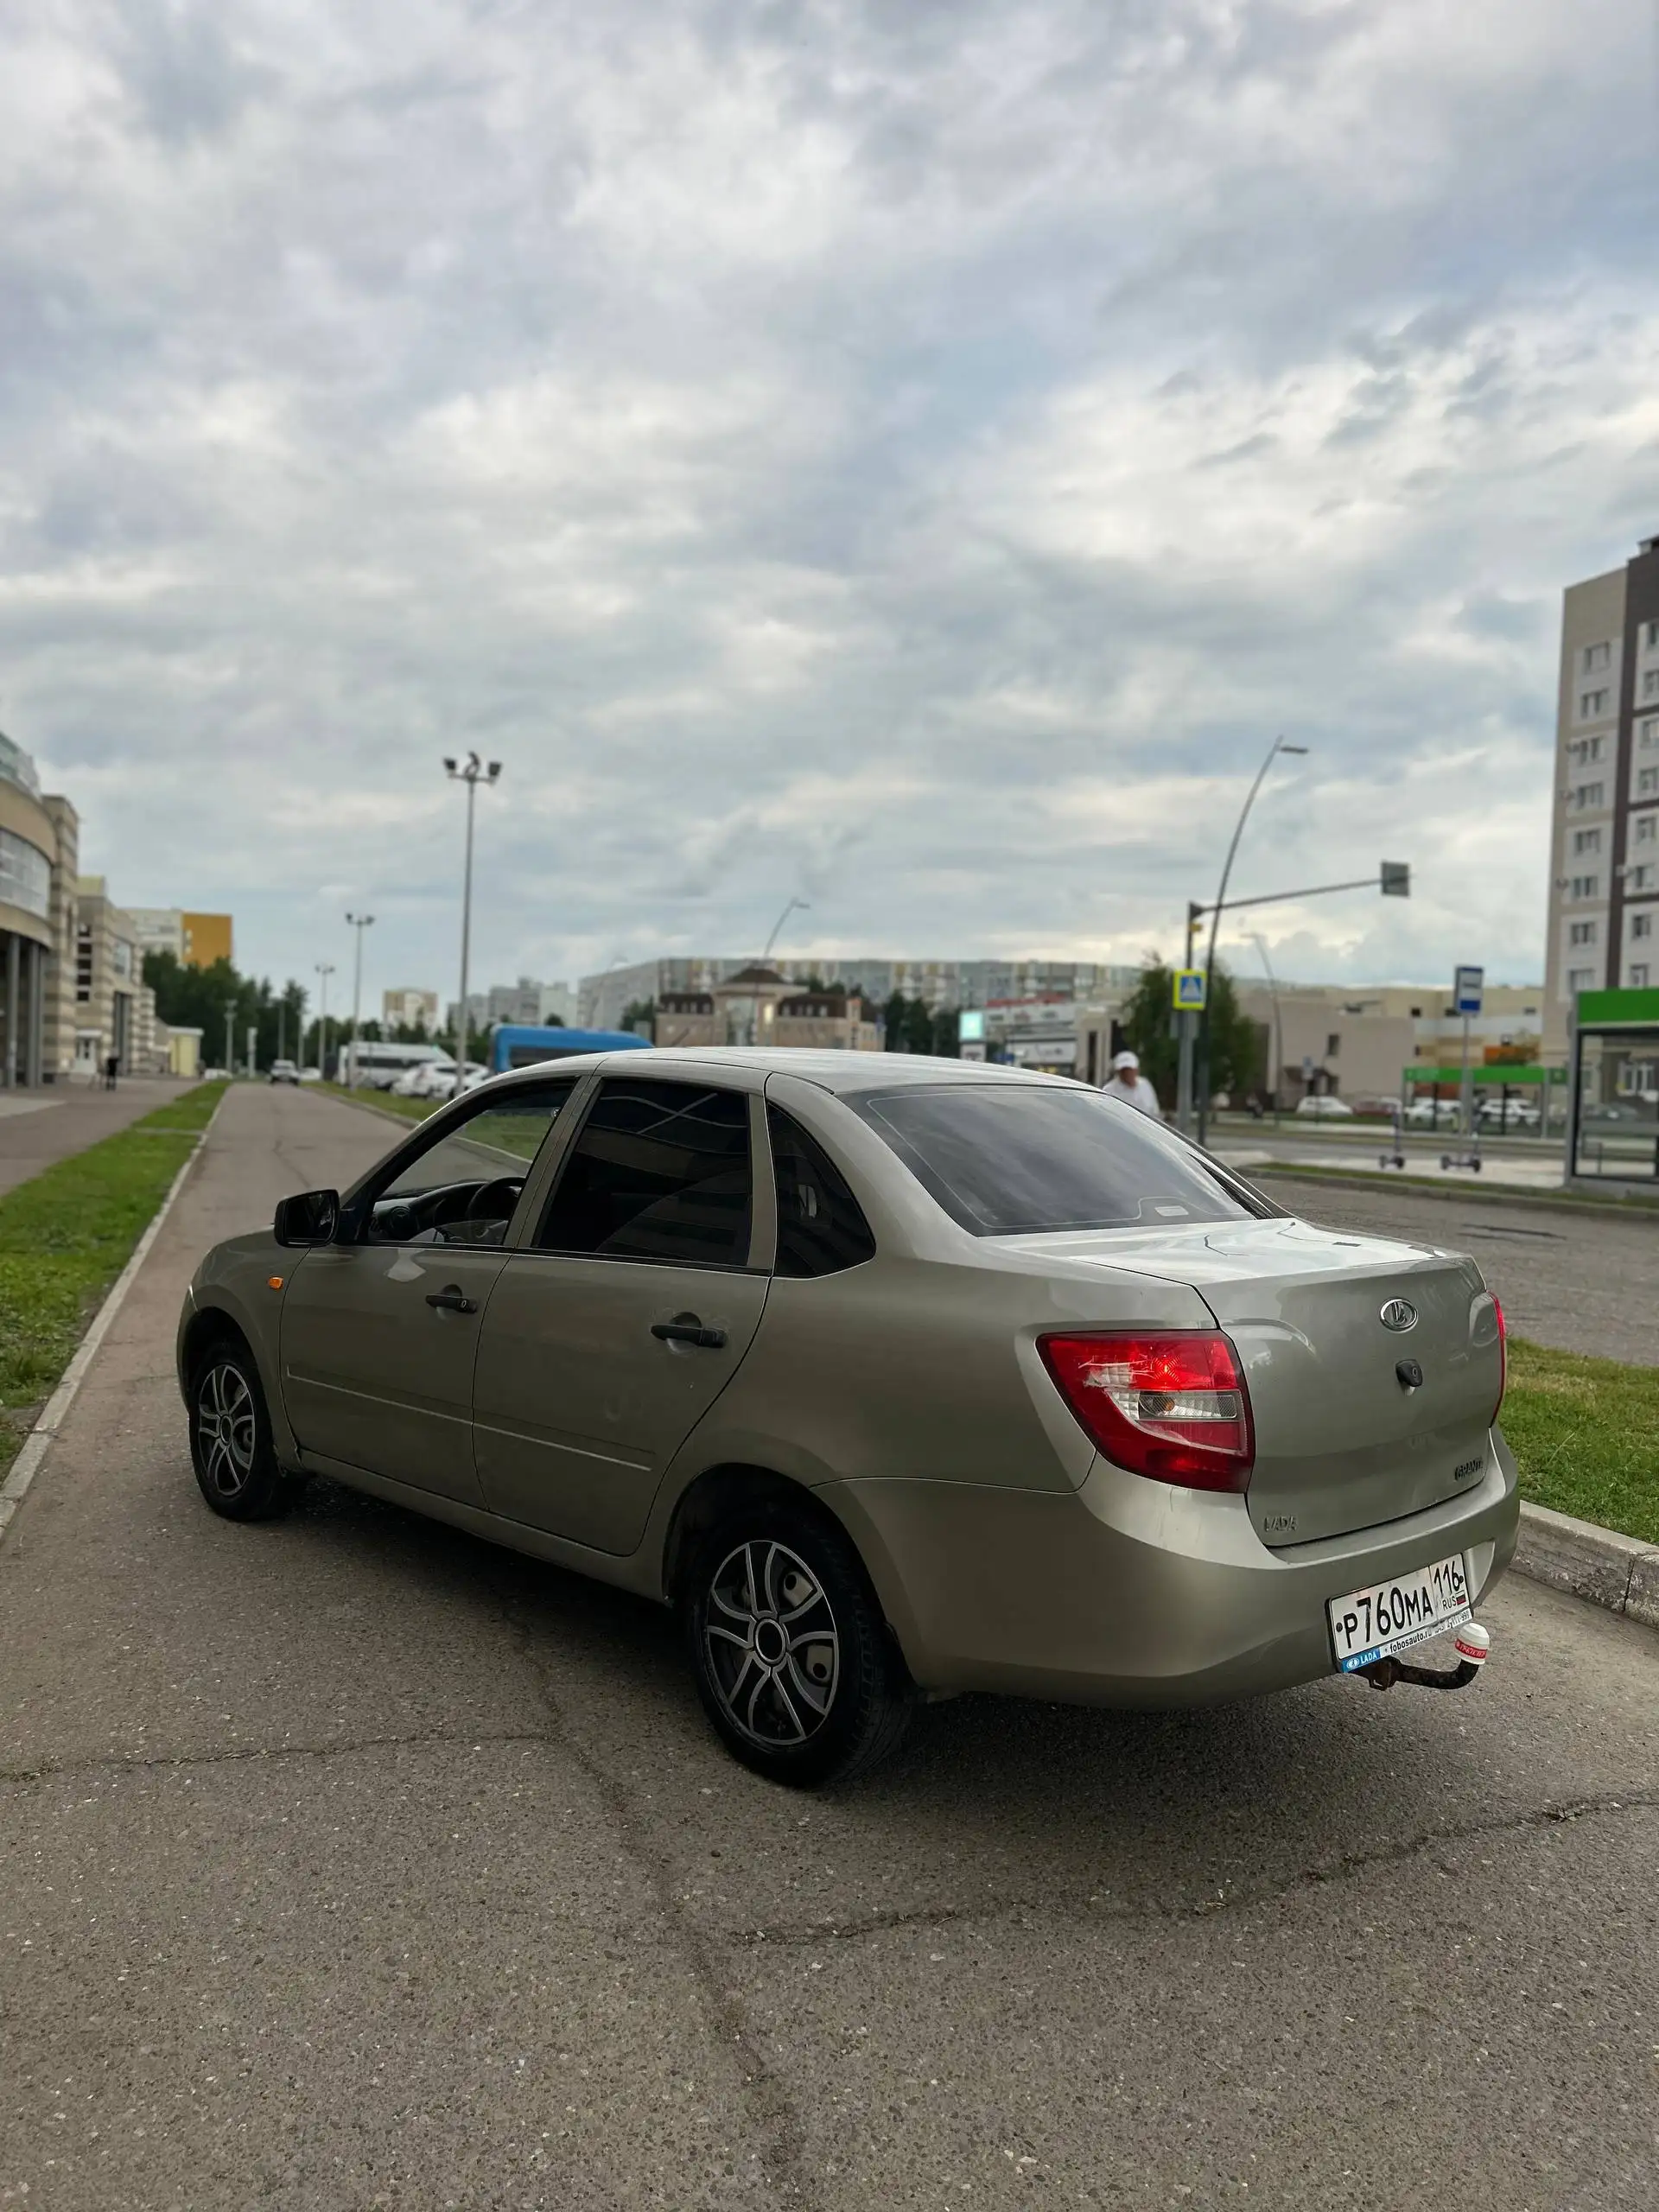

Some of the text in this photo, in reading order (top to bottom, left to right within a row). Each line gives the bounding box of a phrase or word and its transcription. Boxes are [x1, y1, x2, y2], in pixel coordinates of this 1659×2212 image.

[1434, 1560, 1460, 1598] 116
[1442, 1596, 1457, 1611] RUS
[1360, 1651, 1377, 1664] LADA
